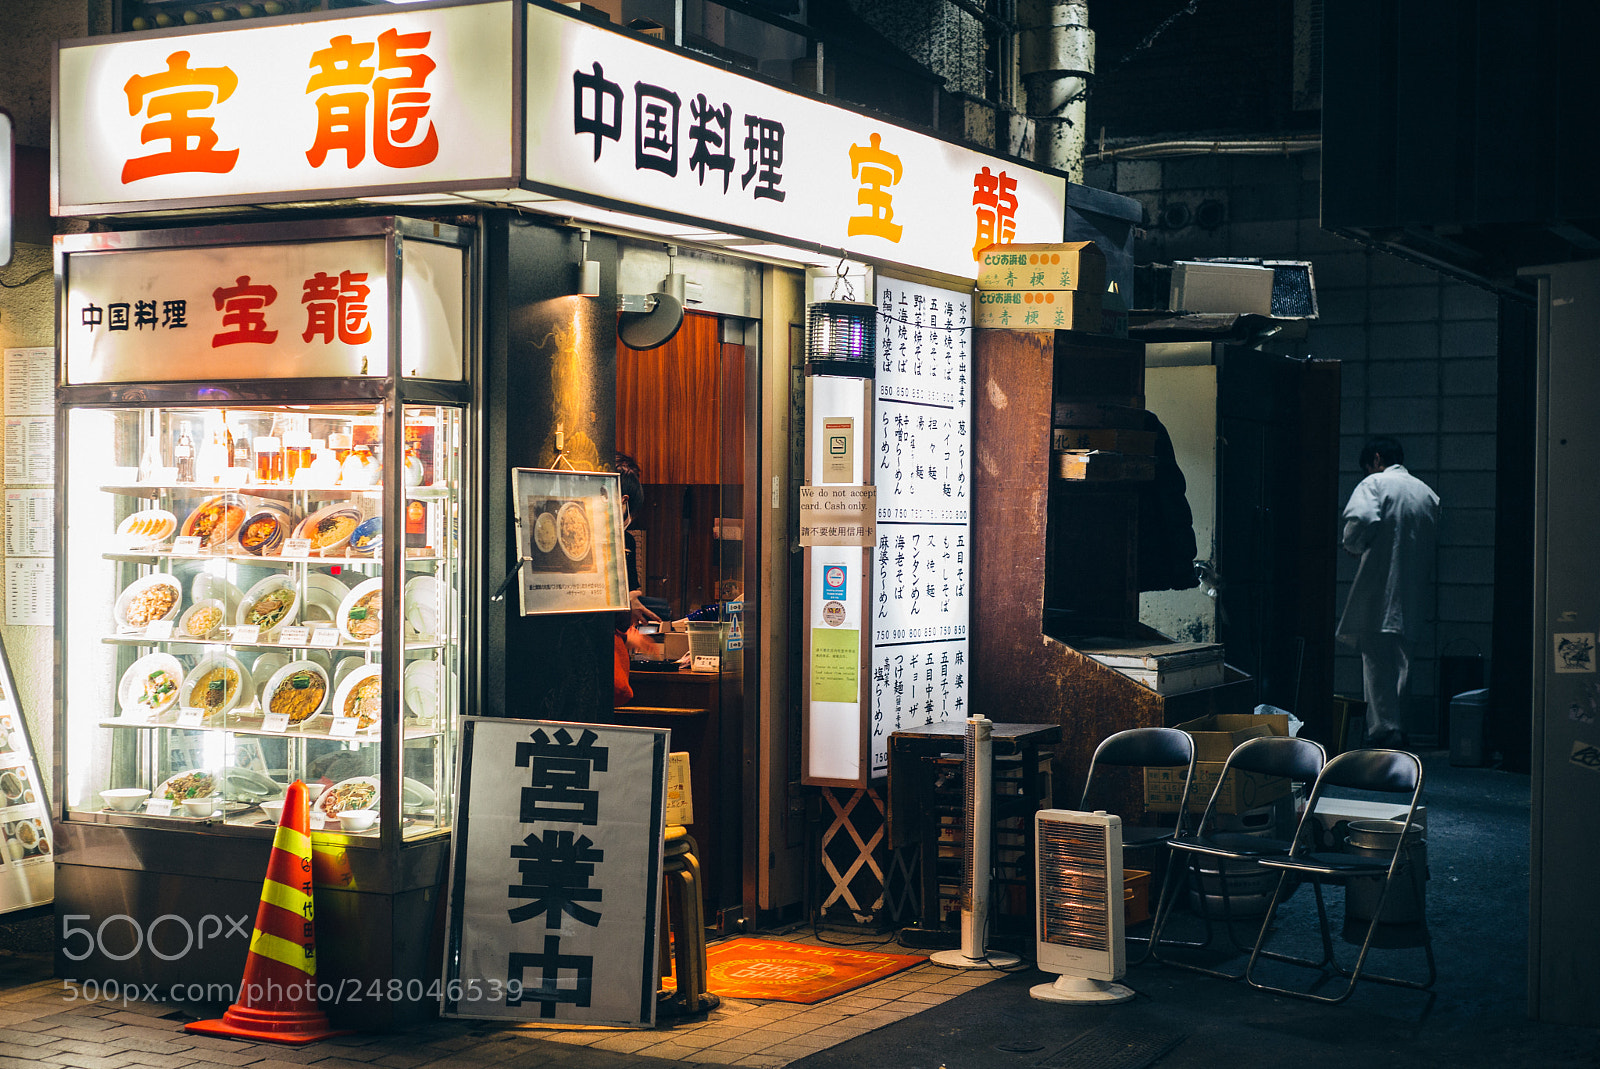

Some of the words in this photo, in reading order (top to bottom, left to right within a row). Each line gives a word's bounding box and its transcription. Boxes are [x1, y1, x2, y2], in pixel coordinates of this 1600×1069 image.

[121, 28, 439, 184] 宝龍
[573, 61, 786, 204] 中国料理
[849, 133, 1019, 262] 宝龍
[81, 301, 188, 331] 中国料理
[212, 269, 373, 348] 宝龍
[880, 385, 893, 395] 850
[880, 411, 890, 469] らーめん
[894, 413, 903, 495] 味噌らーめん
[801, 488, 814, 497] We
[818, 488, 828, 497] do
[832, 489, 846, 497] not
[824, 501, 846, 510] Cash
[848, 501, 868, 512] only.
[878, 508, 891, 518] 650
[895, 508, 907, 518] 750
[801, 526, 874, 537] 請不要使用信用卡
[894, 535, 905, 600] 海老そば
[910, 534, 920, 615] ワンタンめん
[956, 535, 965, 597] 五目そば
[877, 631, 889, 640] 750
[893, 629, 905, 639] 900
[954, 625, 966, 635] 850
[874, 667, 884, 737] 塩らーめん
[909, 654, 919, 718] ギョーザ
[875, 752, 888, 764] 750
[505, 727, 609, 1018] 営業中
[302, 881, 314, 959] 千代田区
